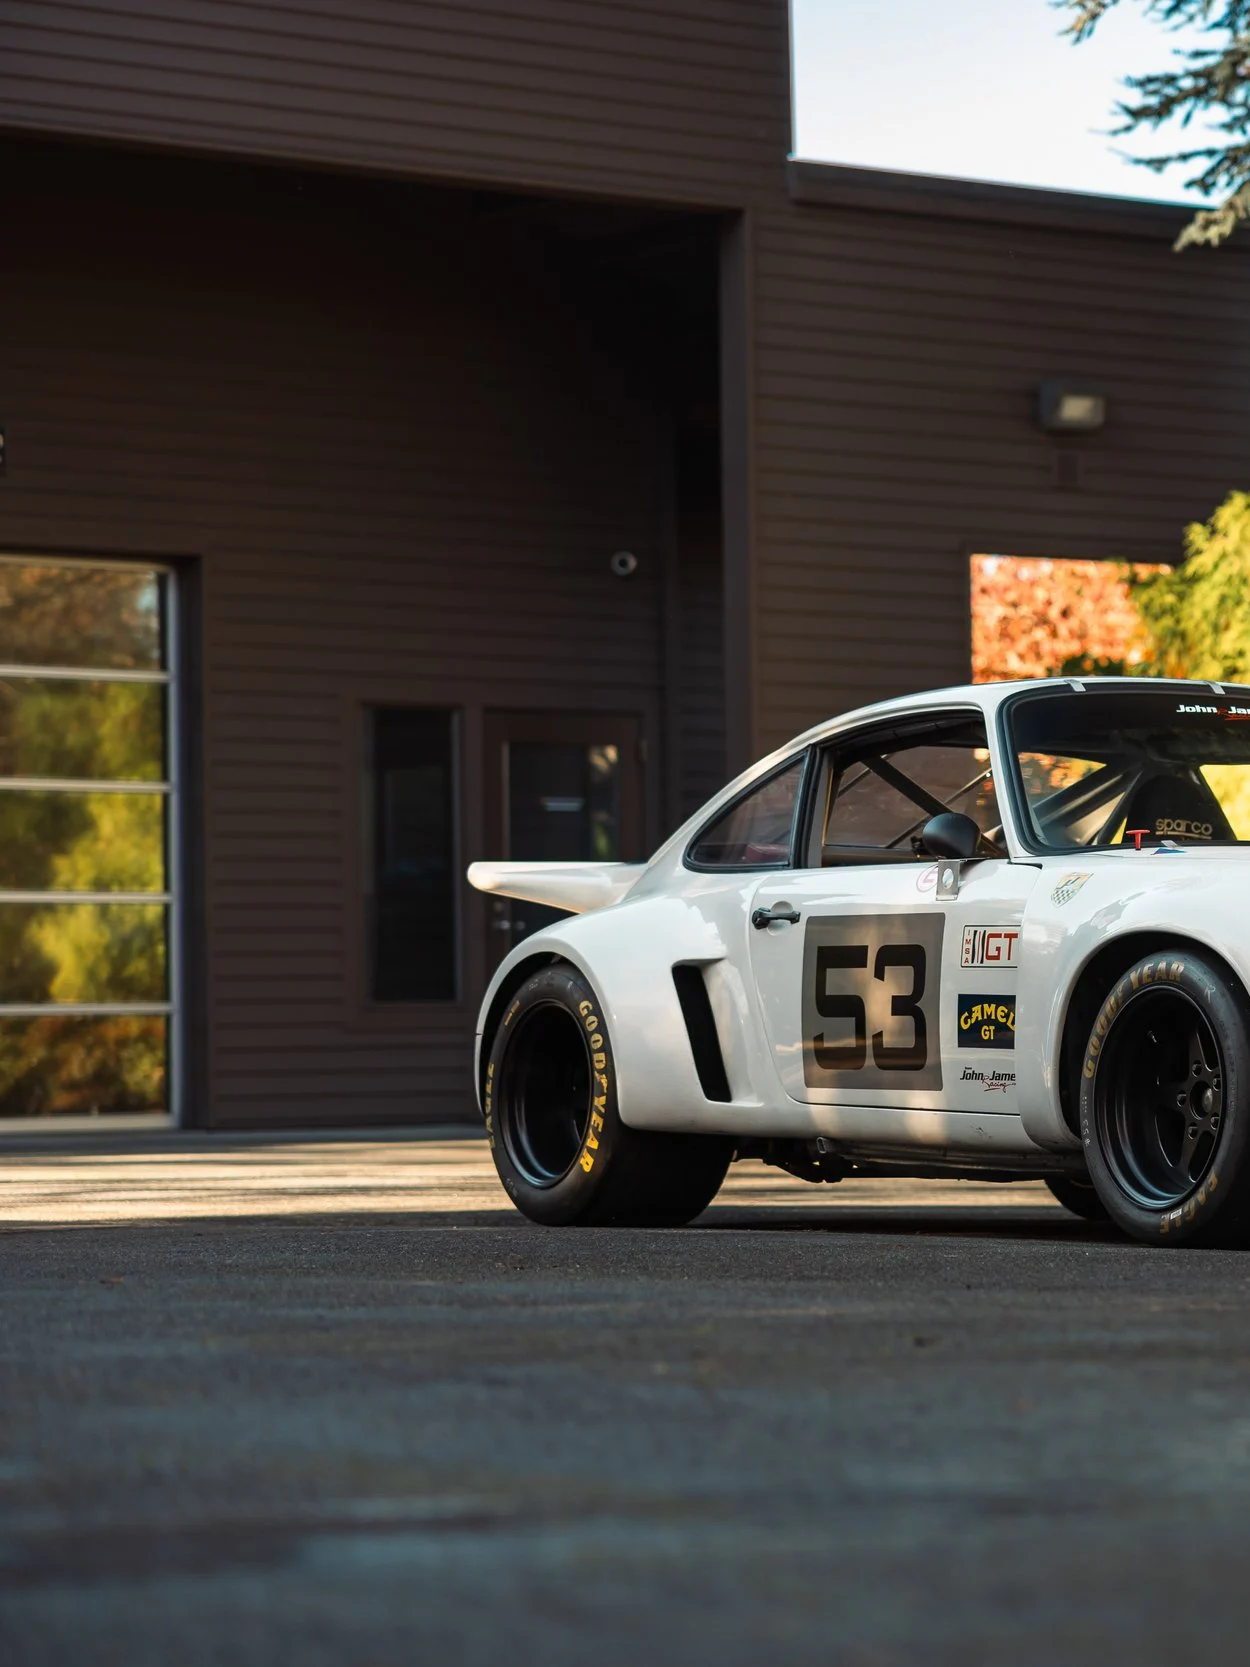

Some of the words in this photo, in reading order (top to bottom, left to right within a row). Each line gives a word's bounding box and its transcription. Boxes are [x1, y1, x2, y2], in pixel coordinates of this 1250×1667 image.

[1176, 704, 1218, 713] John
[1155, 818, 1214, 836] sparco
[964, 929, 972, 964] IMSA
[985, 932, 1019, 961] GT
[813, 944, 928, 1071] 53
[960, 1003, 1016, 1031] CAMEL
[981, 1025, 996, 1040] GT
[960, 1070, 984, 1081] John
[989, 1070, 1016, 1081] Jame
